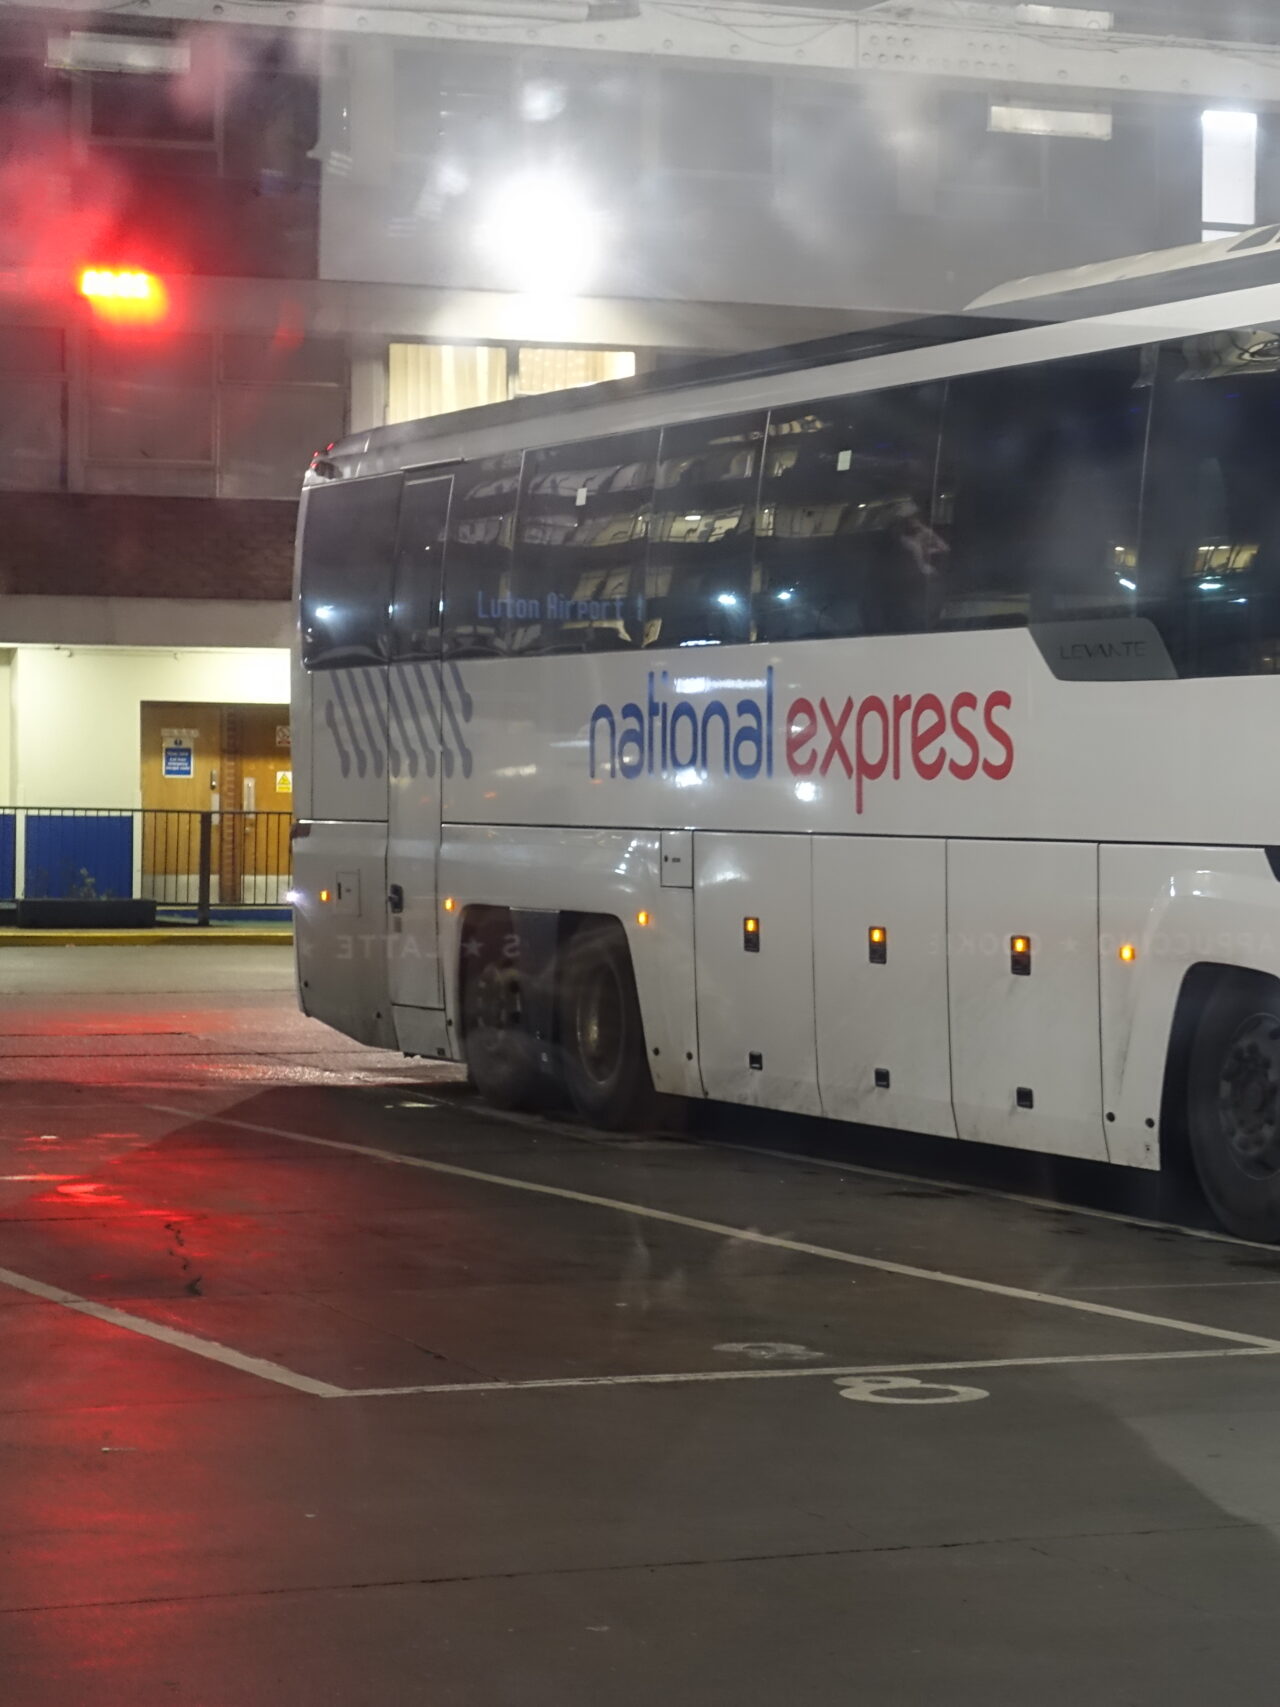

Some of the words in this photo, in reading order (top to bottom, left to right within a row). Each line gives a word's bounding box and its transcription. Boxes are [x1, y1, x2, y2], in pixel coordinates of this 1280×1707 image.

[1059, 640, 1147, 660] LEVANTE
[588, 665, 774, 780] national
[786, 690, 1015, 815] express
[833, 1376, 990, 1404] 8
